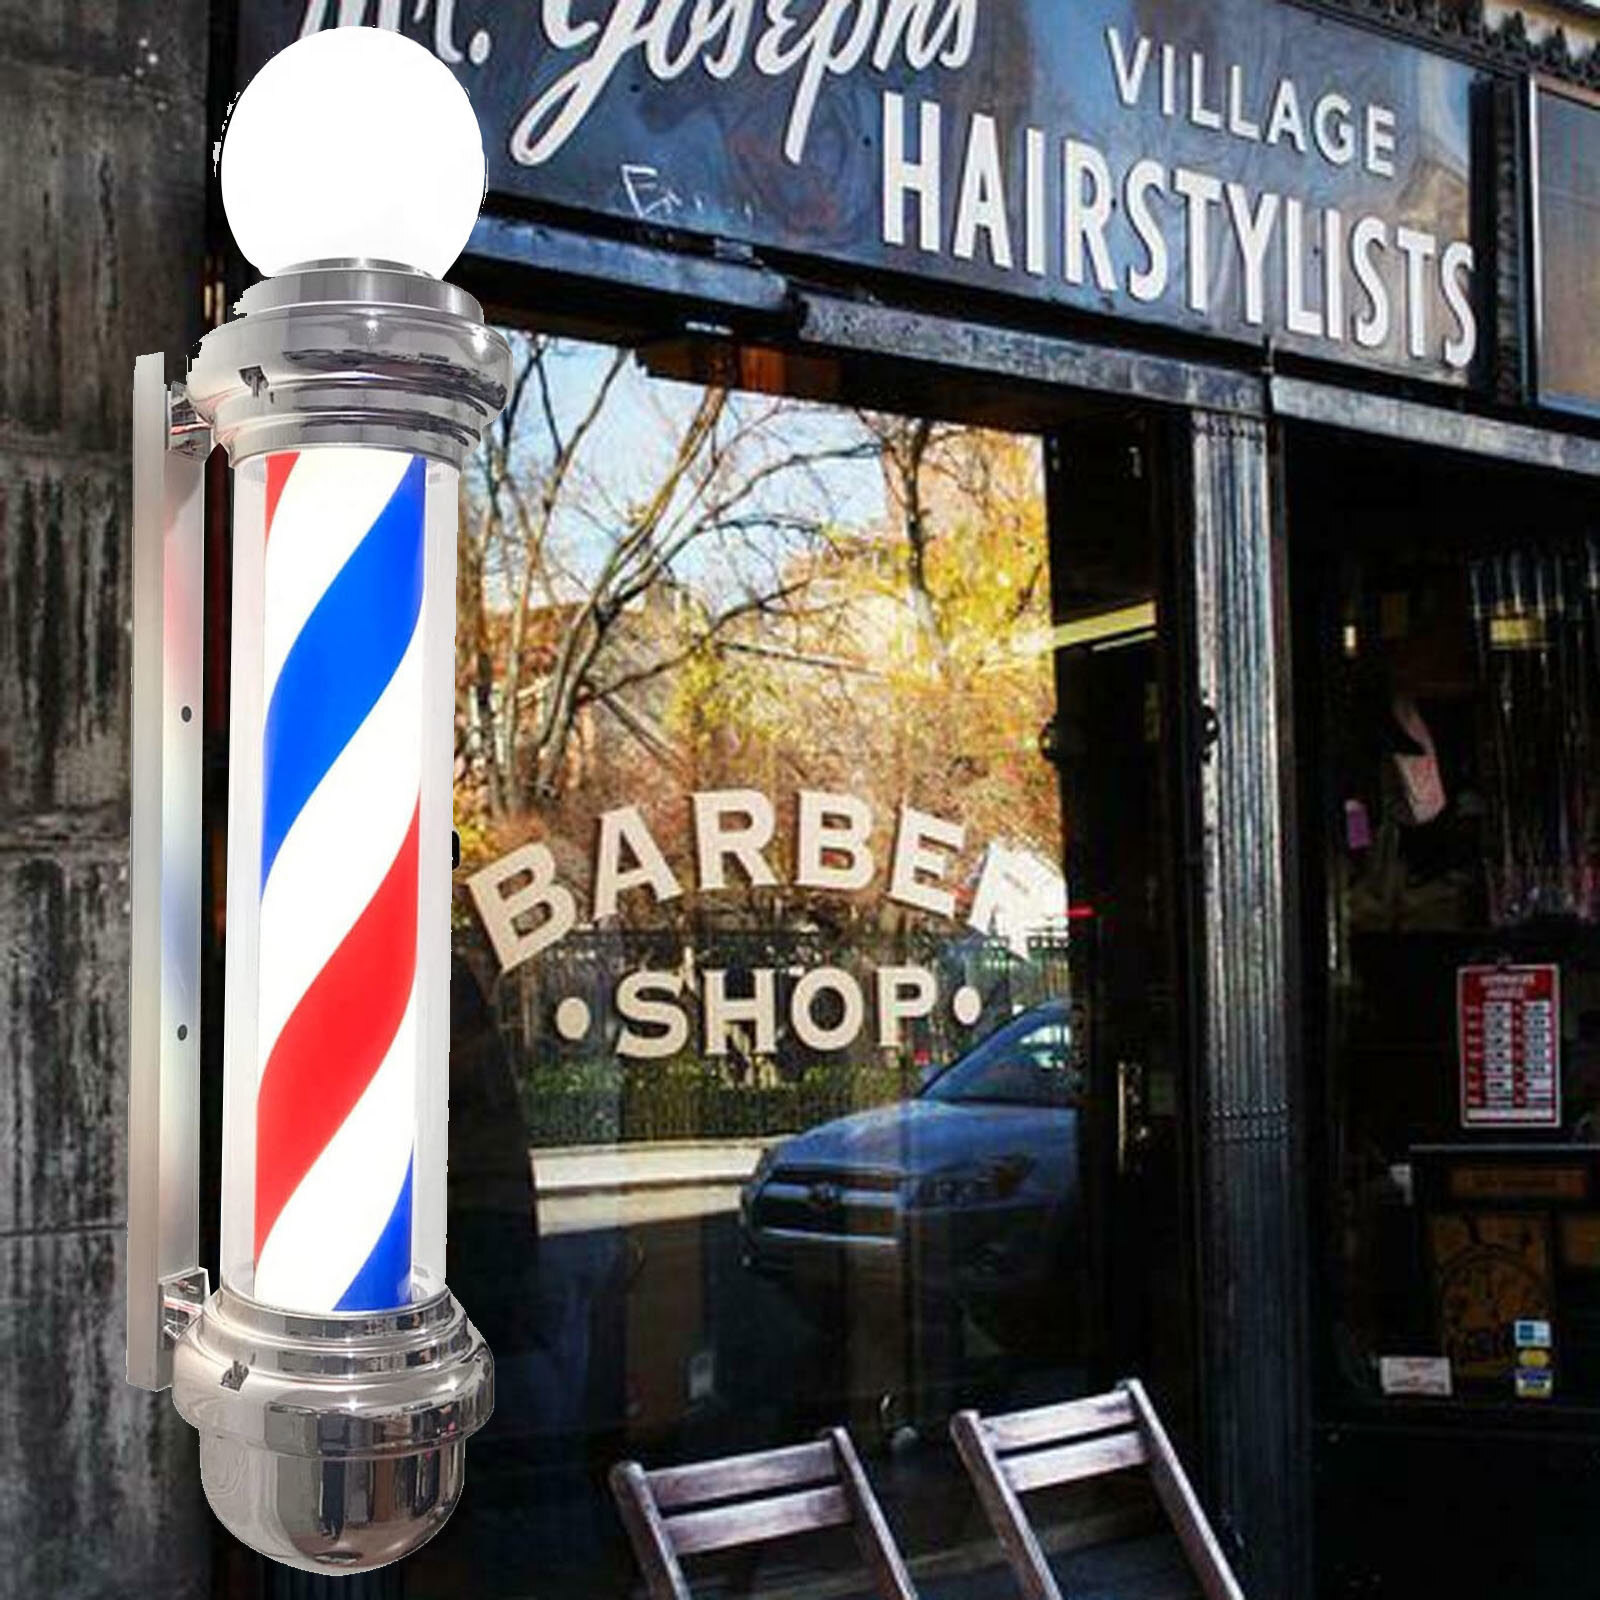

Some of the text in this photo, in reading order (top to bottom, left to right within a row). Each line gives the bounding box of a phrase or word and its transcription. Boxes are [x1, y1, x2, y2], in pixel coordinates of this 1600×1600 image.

[1107, 28, 1396, 178] VILLAGE
[882, 91, 1476, 367] HAIRSTYLISTS
[465, 789, 1060, 973] BARBER
[615, 966, 939, 1060] SHOP
